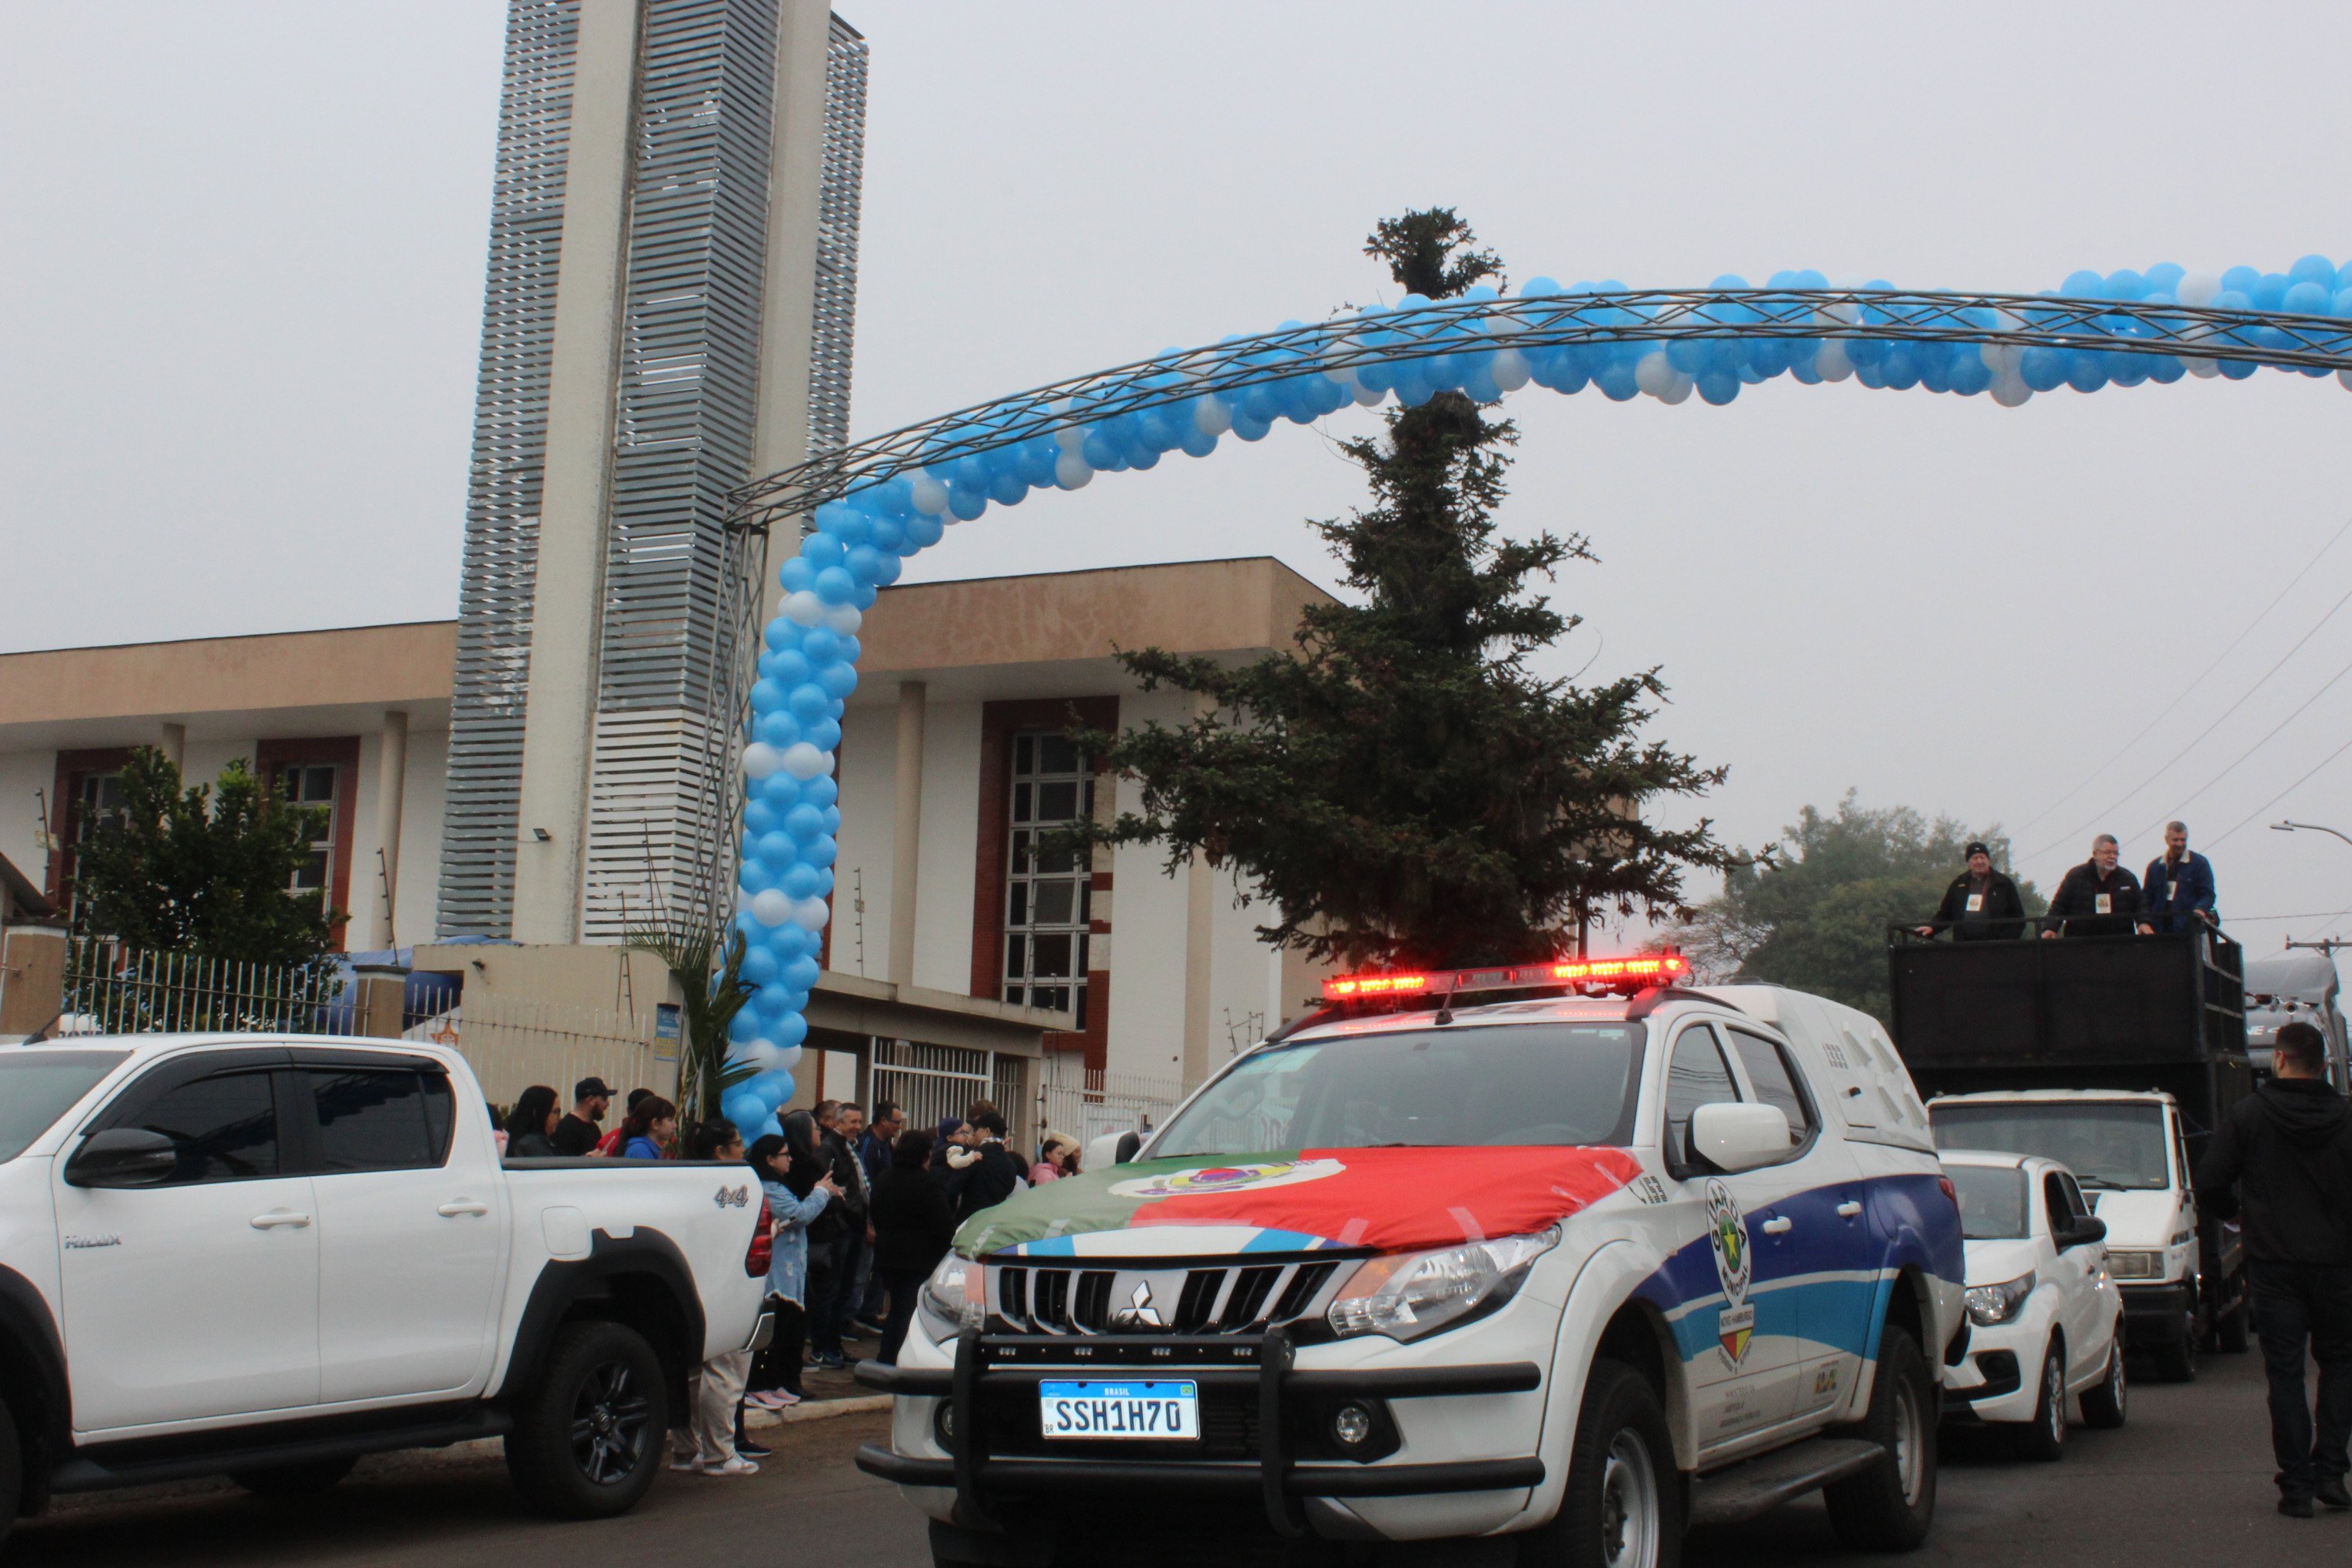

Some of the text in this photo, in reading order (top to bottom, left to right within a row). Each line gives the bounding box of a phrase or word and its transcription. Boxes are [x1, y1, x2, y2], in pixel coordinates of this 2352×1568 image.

[1708, 1184, 1747, 1251] GUARDA
[1722, 1265, 1749, 1297] MUNICIPAL
[1105, 1387, 1130, 1397] BRASIL
[1045, 1423, 1054, 1434] BR
[1056, 1400, 1181, 1432] SSH1H70
